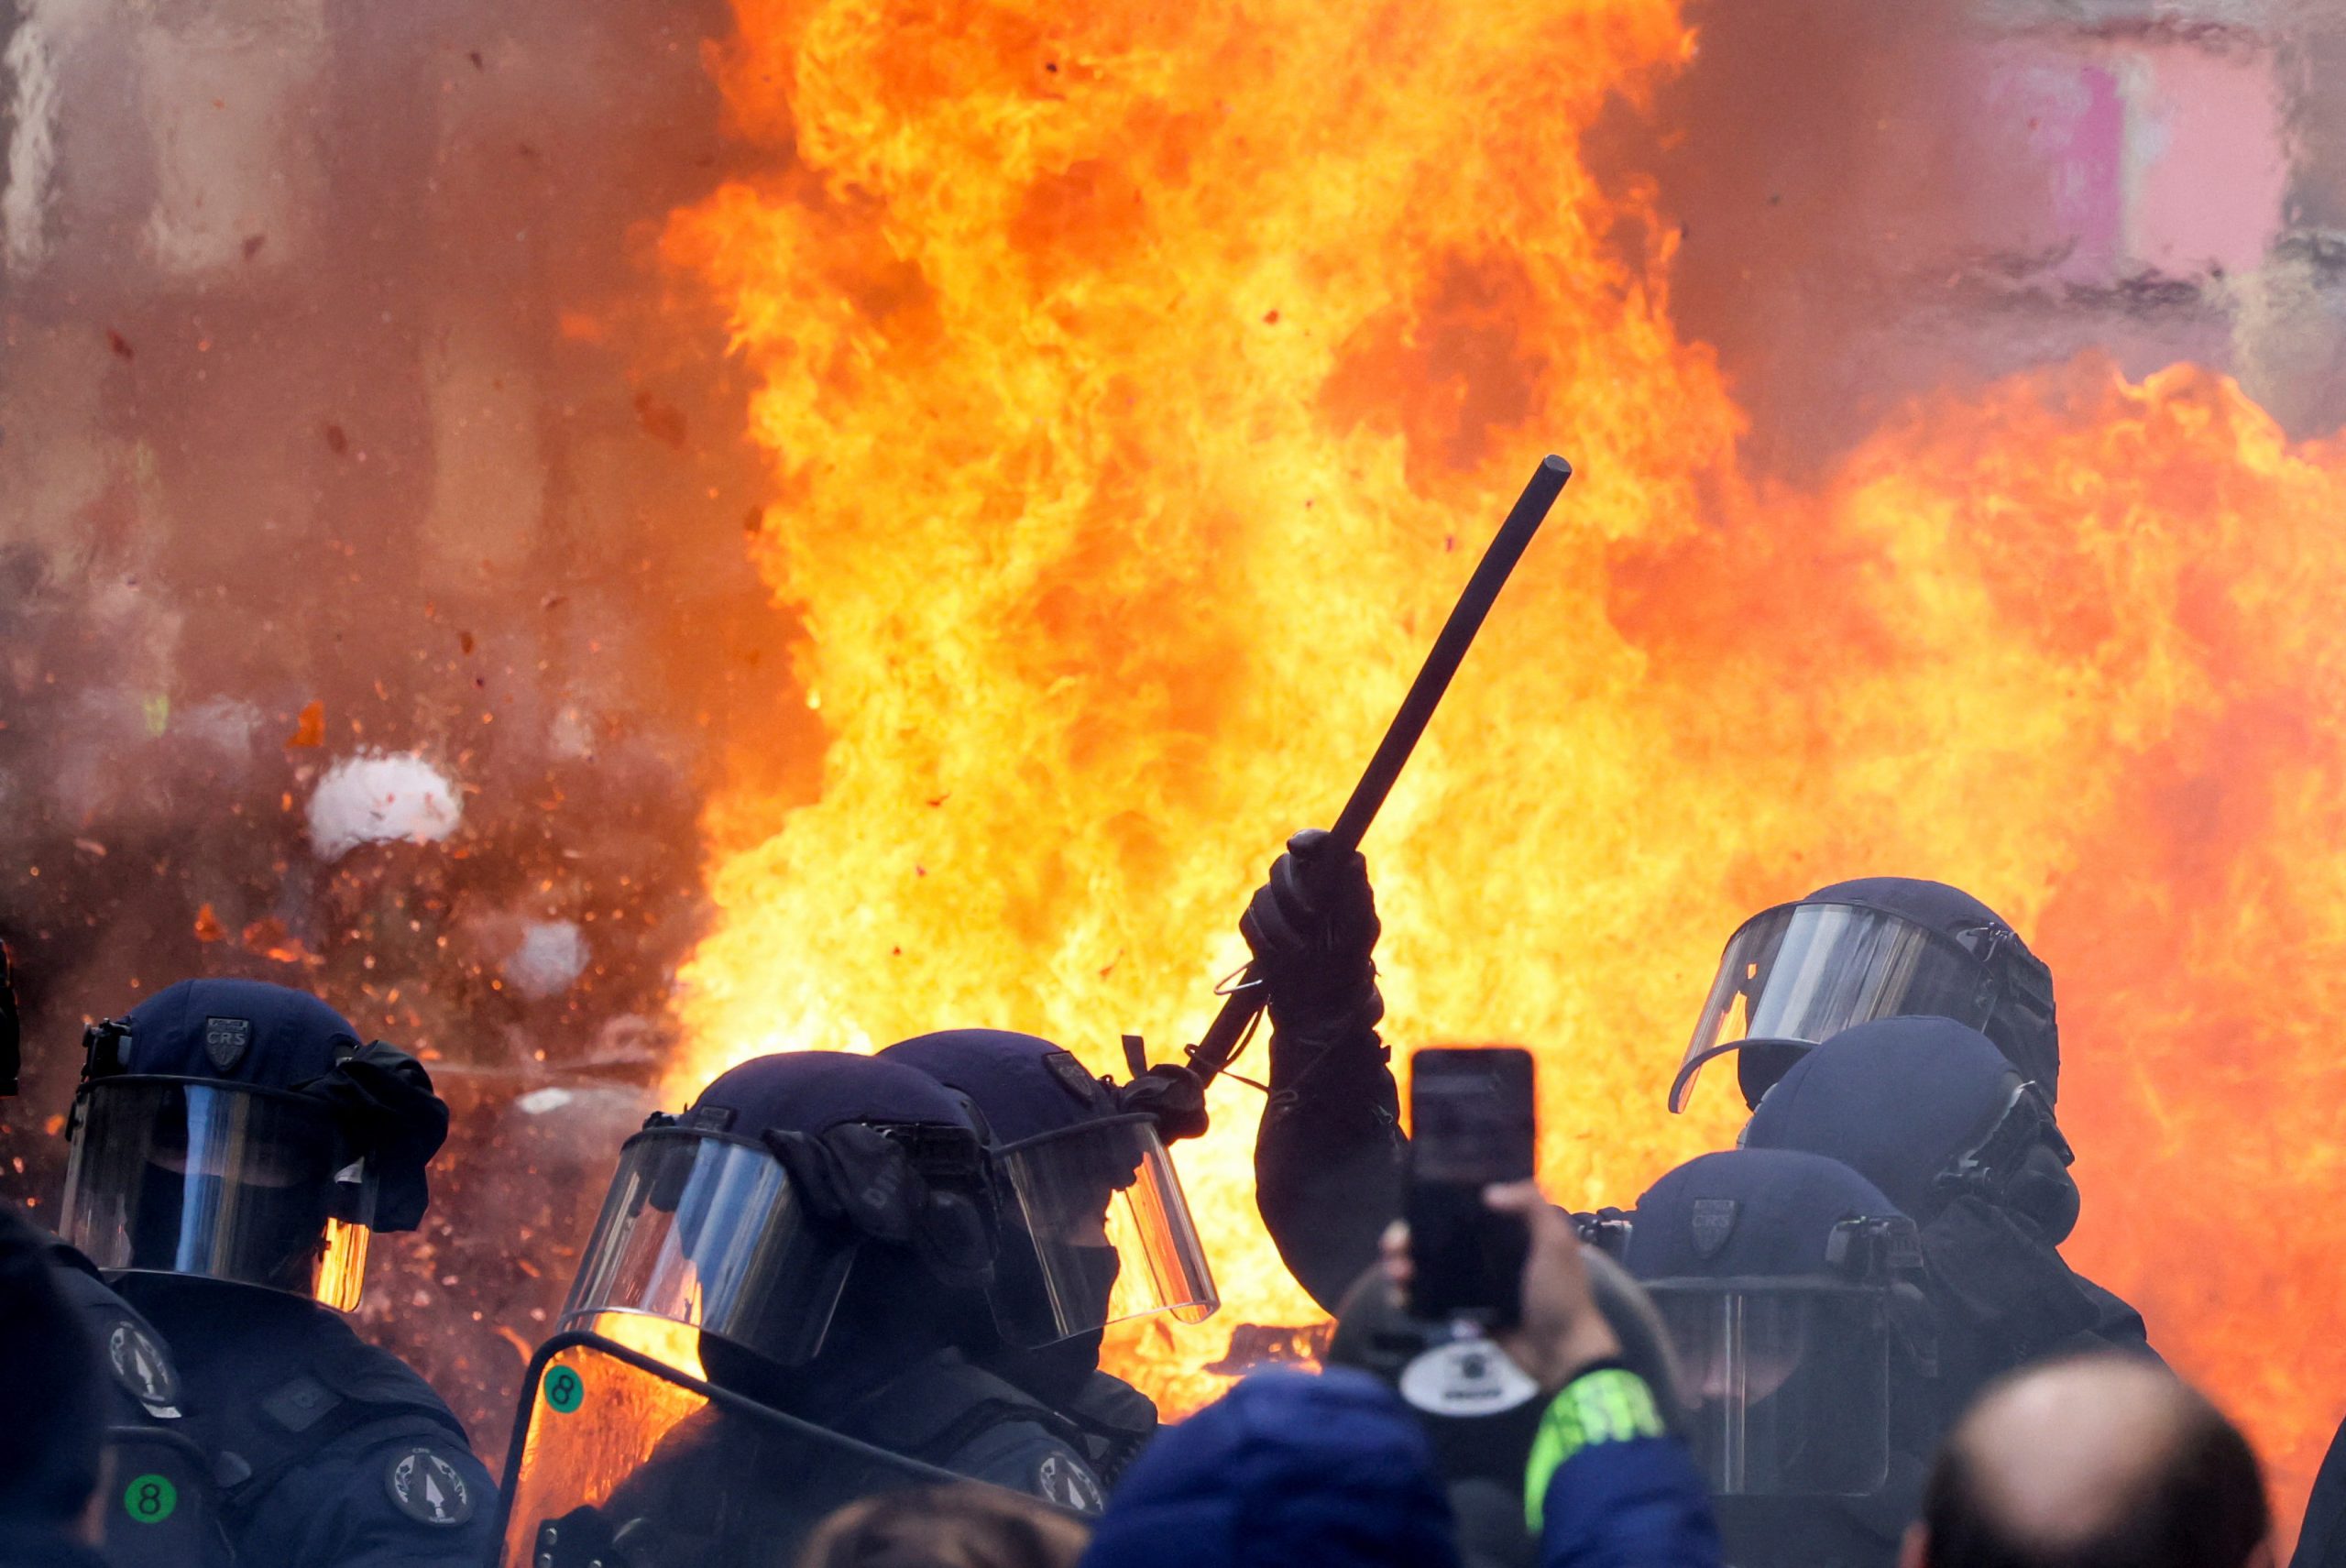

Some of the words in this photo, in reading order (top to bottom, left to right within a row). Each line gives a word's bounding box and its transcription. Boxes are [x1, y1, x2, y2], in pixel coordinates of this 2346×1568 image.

[207, 1032, 246, 1046] CRS
[1692, 1214, 1730, 1228] CRS
[552, 1375, 575, 1405] 8
[138, 1483, 161, 1515] 8
